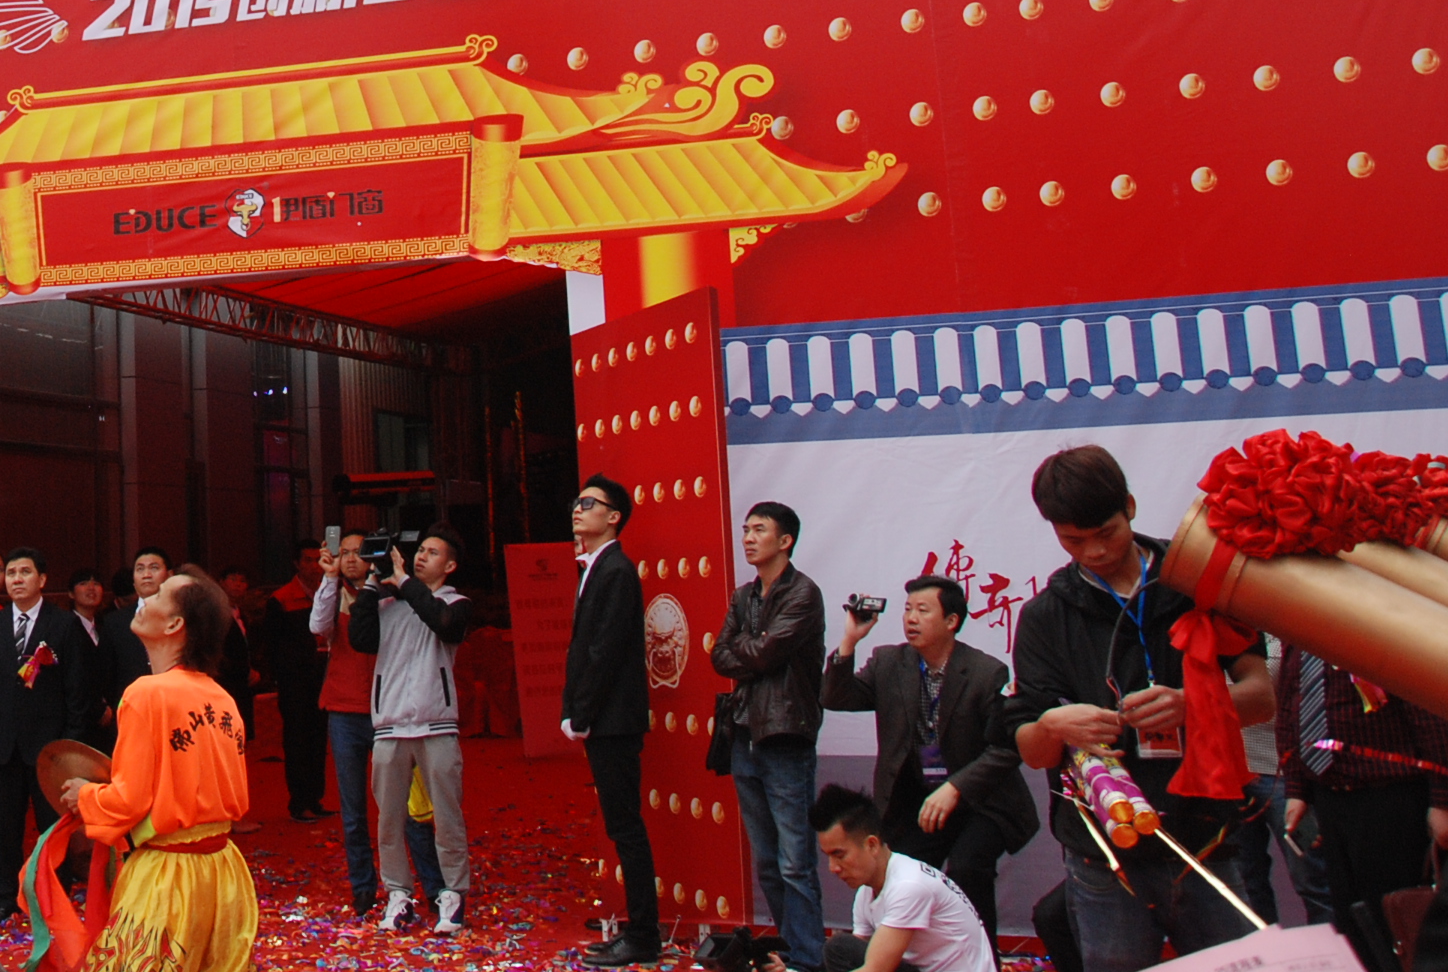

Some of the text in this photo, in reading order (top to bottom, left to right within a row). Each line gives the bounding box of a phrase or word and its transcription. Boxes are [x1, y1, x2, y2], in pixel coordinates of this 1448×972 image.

[113, 204, 218, 236] EDUCE
[272, 190, 384, 223] 伊盾门窗
